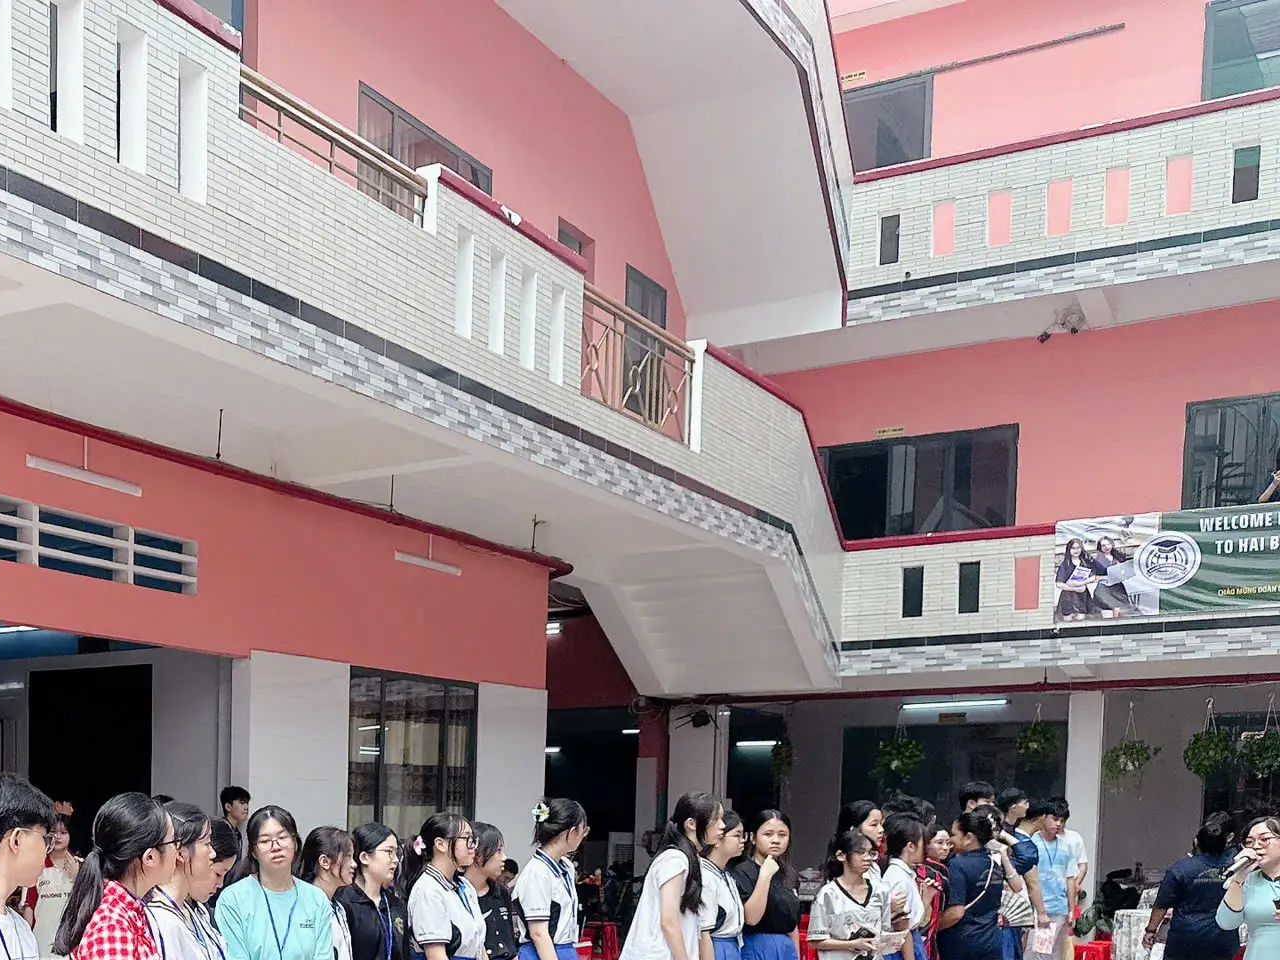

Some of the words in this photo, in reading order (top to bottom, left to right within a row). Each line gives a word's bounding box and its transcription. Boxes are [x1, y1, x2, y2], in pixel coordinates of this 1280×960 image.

[1200, 512, 1273, 532] WELCOME
[1215, 539, 1234, 555] TO
[1238, 537, 1265, 553] HAI
